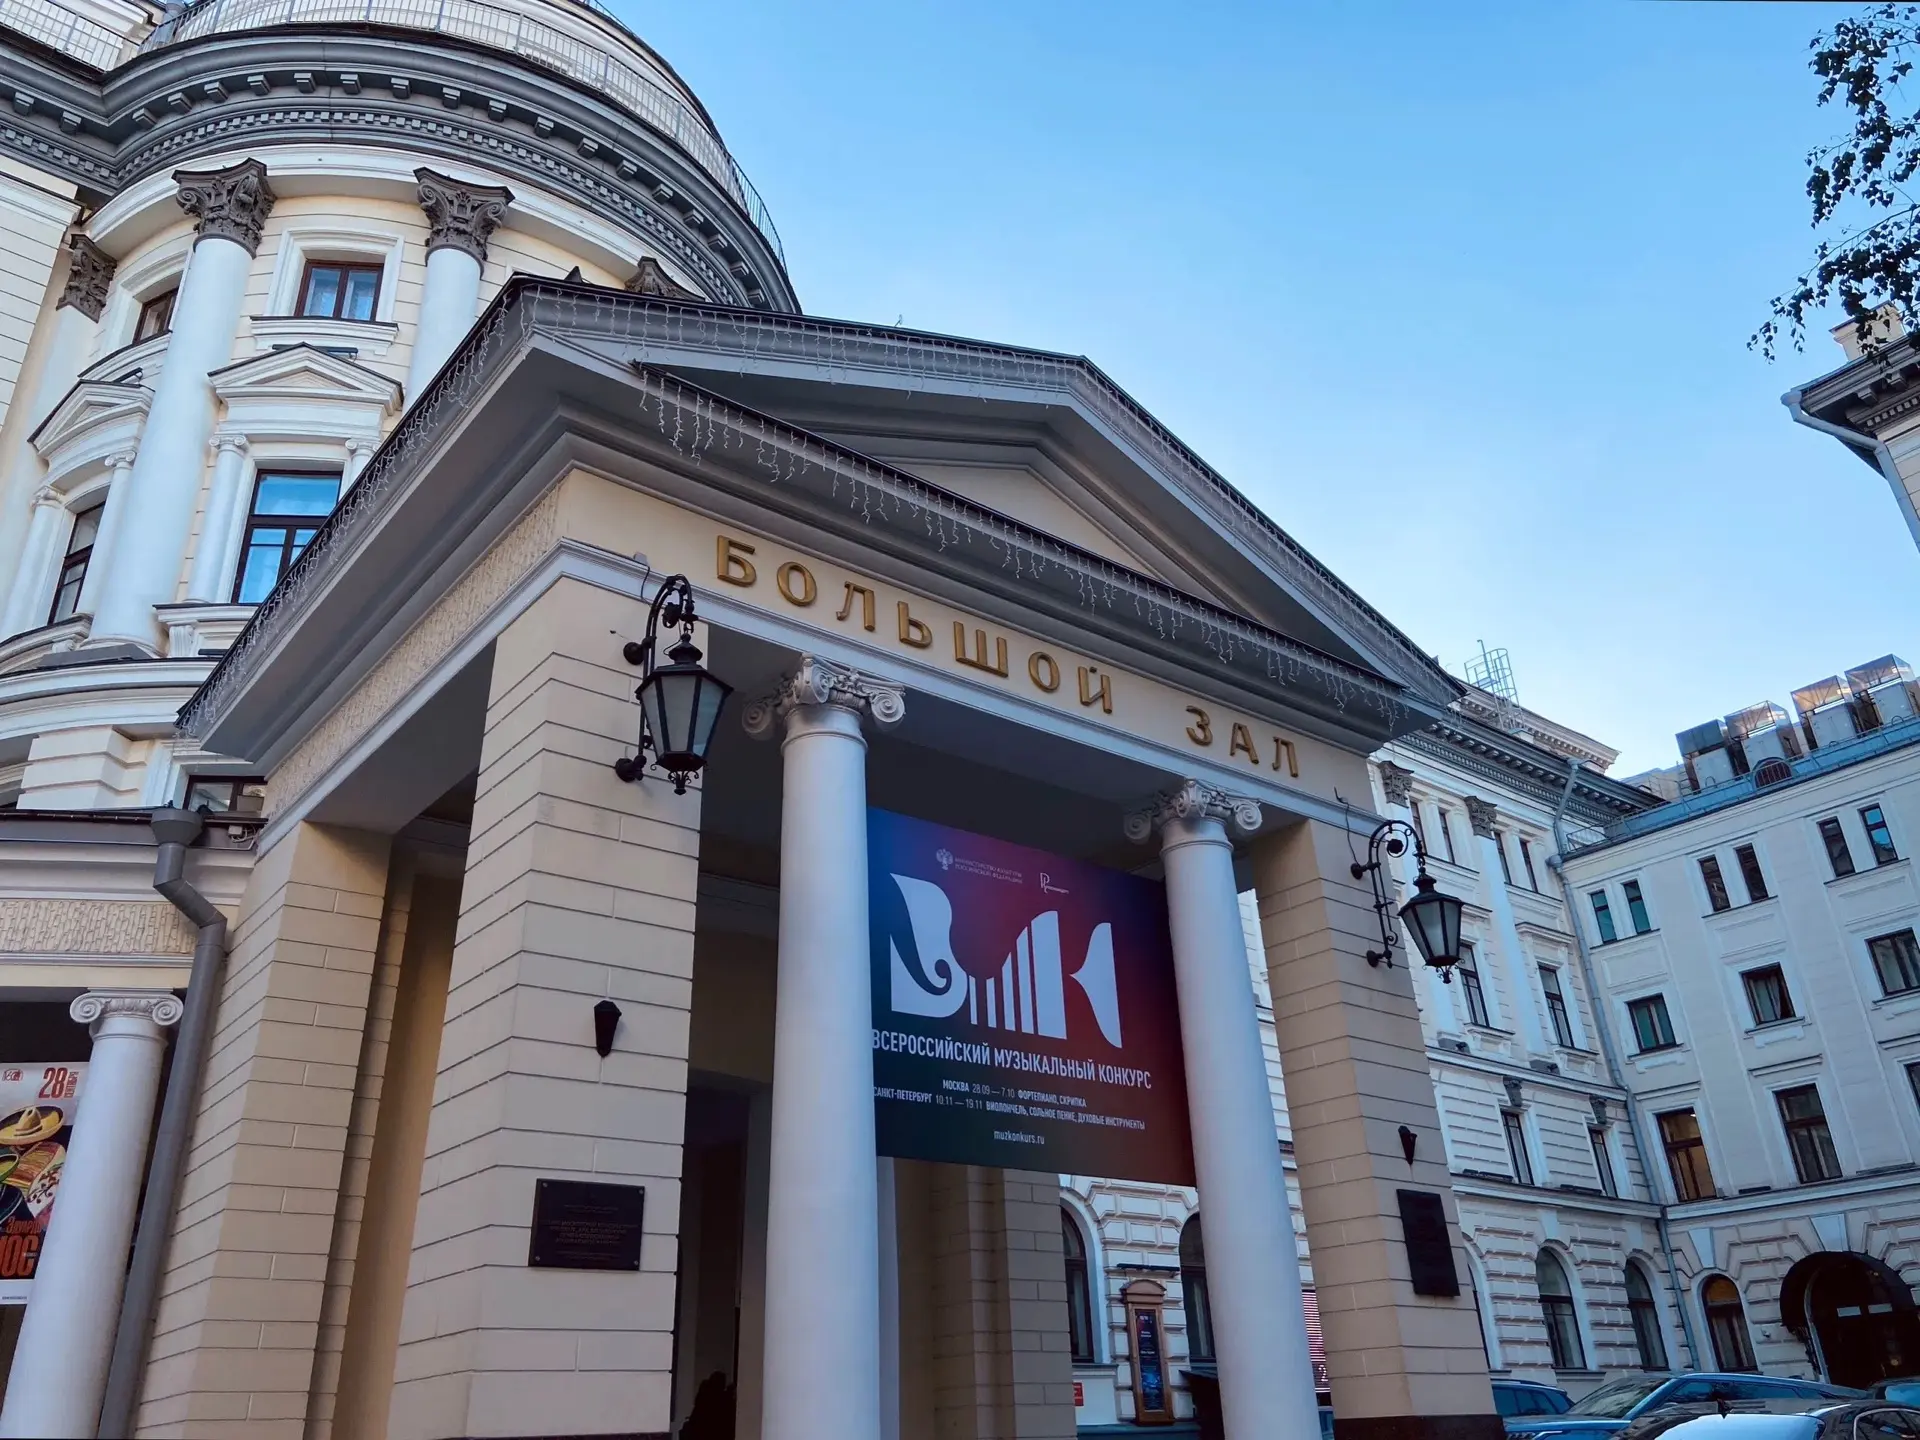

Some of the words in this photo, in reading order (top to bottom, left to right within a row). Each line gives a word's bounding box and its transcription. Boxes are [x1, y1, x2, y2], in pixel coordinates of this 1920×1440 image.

[716, 534, 1113, 714] БОЛЬШОЙ
[1185, 705, 1299, 778] ЗАЛ
[872, 1029, 990, 1066] ВСЕРОССИЙСКИЙ
[994, 1048, 1096, 1081] МУЗЫКАЛЬНЫЙ
[1098, 1064, 1152, 1089] КОНКУРС
[38, 1067, 68, 1098] 28
[943, 1079, 970, 1092] МОСКВА
[972, 1083, 990, 1095] 28.09
[1001, 1087, 1015, 1099] 7.10
[1018, 1089, 1059, 1104] ФОРТЕПИАНО,
[1060, 1095, 1087, 1107] СКРИПКА
[873, 1086, 932, 1103] САНКТ-ПЕТЕРБУРГ
[936, 1094, 953, 1106] 10.11
[966, 1098, 983, 1109] 19.11
[1029, 1106, 1056, 1119] СОЛЬНОЕ
[1077, 1112, 1105, 1125] ДУХОВЫЕ
[1105, 1116, 1145, 1130] ИНСТРУМЕНТЫ
[994, 1130, 1045, 1145] muzkonkurs.ru
